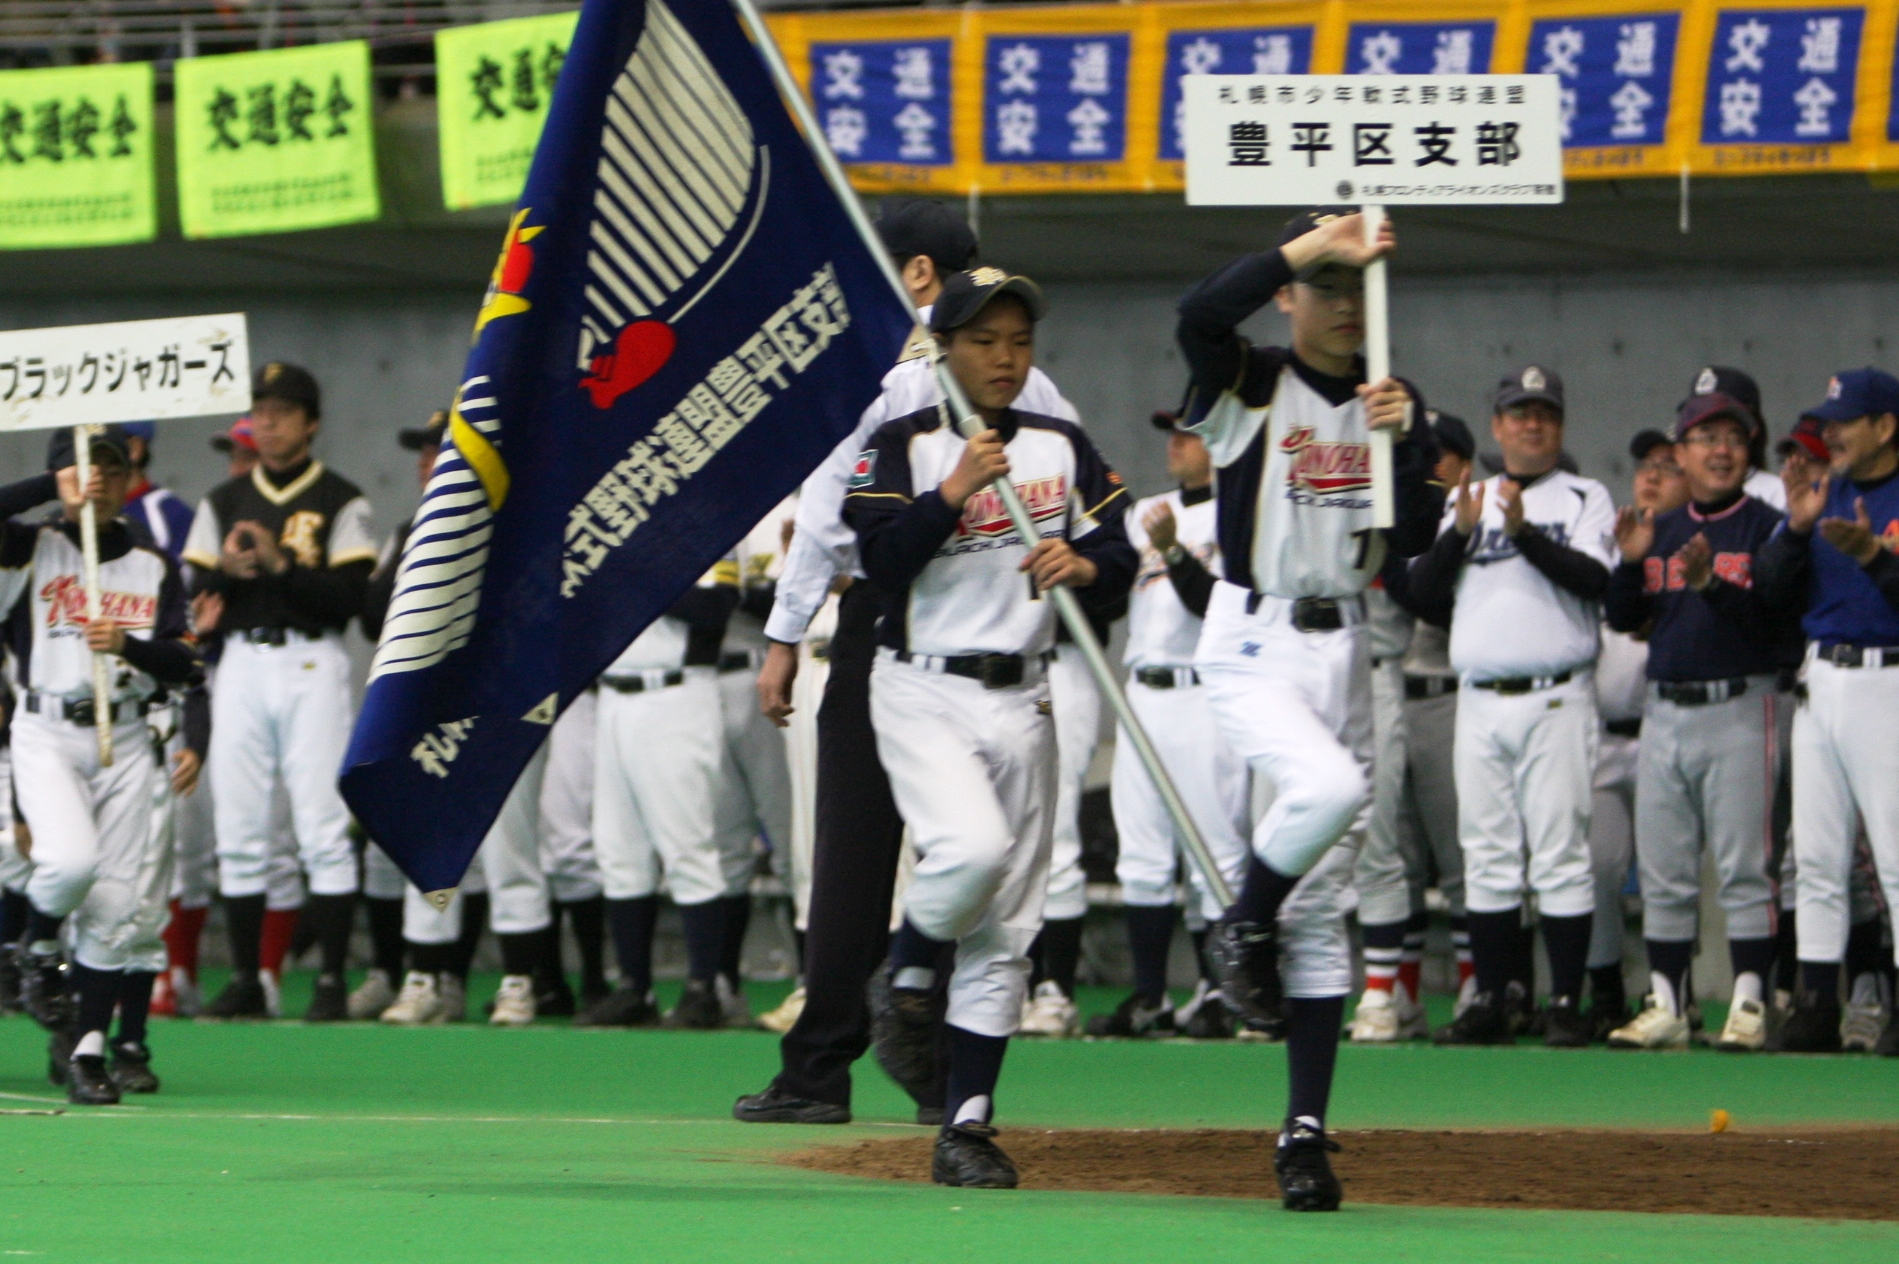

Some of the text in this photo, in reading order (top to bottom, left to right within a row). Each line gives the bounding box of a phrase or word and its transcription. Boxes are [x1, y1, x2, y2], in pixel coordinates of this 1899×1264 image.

[1000, 43, 1110, 95] 交通
[1541, 22, 1657, 78] 交通
[1727, 18, 1841, 72] 交通
[824, 48, 934, 99] 交通
[1219, 84, 1526, 104] 札幌市少年軟式野球連盟
[207, 74, 354, 152] 交通安全
[826, 103, 935, 158] 安全
[998, 99, 1110, 155] 安全
[1720, 78, 1837, 136] 安全
[1228, 121, 1521, 168] 豊平区支部
[0, 340, 235, 401] ブラックジャガーズ
